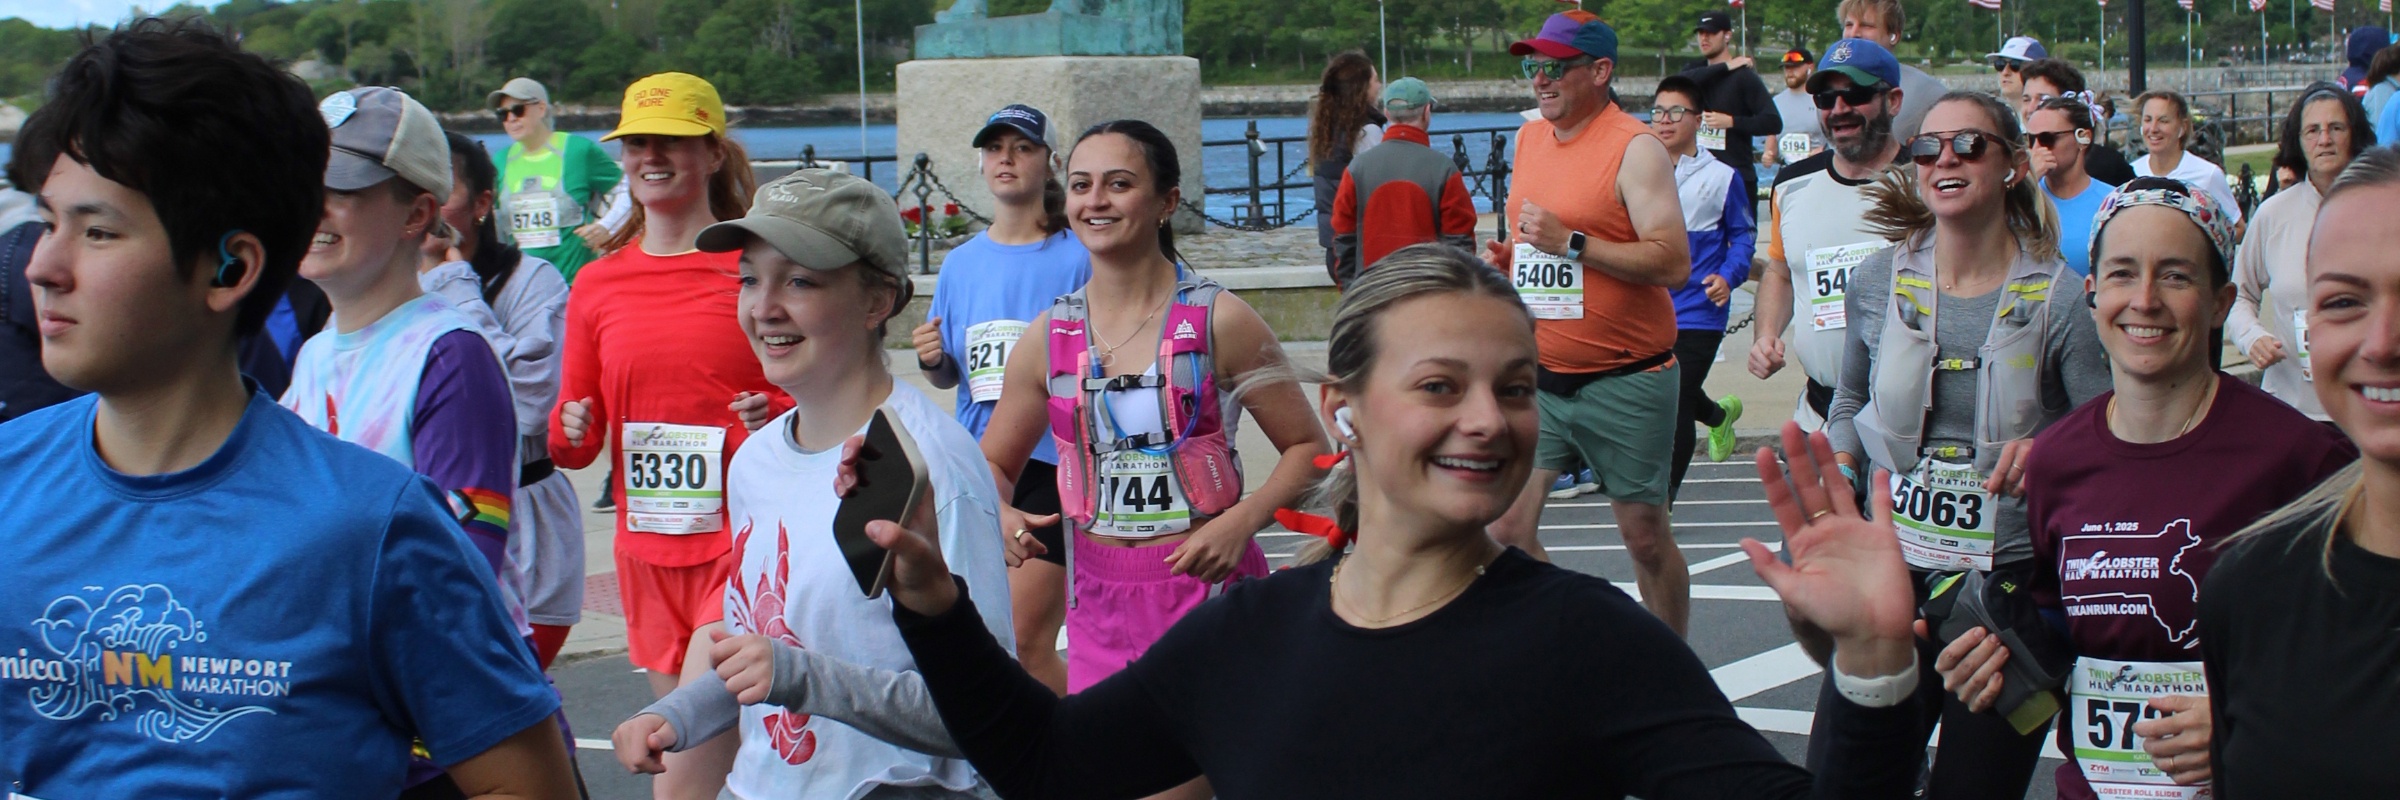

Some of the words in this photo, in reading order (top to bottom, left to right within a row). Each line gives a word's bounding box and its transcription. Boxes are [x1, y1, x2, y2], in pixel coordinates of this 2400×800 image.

[650, 88, 673, 98] ONE
[637, 98, 665, 108] MORE
[1782, 141, 1806, 151] 5194
[513, 211, 553, 229] 5748
[1516, 263, 1574, 288] 5406
[1816, 266, 1857, 297] 54
[664, 431, 708, 440] LOBSTER
[653, 440, 708, 448] MARATHON
[1118, 452, 1167, 461] LOBSTER
[631, 453, 708, 490] 5330
[1929, 476, 1982, 488] ARATHON
[1892, 477, 1983, 530] 5063
[2081, 523, 2103, 532] June
[2104, 522, 2113, 533] 1,
[2114, 522, 2139, 531] 2025
[2066, 558, 2087, 570] TWIN
[2104, 557, 2160, 569] LOBSTER
[2065, 570, 2085, 581] HALF
[2091, 569, 2160, 579] MARATHON
[2066, 604, 2148, 616] YUKANRUN.COM
[103, 650, 173, 689] NM
[181, 656, 293, 678] NEWPORT
[2087, 667, 2114, 680] TWIN
[2137, 671, 2202, 683] LOBSTER
[181, 677, 291, 696] MARATHON
[2089, 680, 2116, 692] HALF
[2123, 683, 2205, 693] MARATHON
[2090, 764, 2110, 772] ZYM
[2099, 787, 2132, 796] LOBSTER
[2134, 788, 2153, 797] ROLL
[2155, 790, 2183, 798] SLIDER
